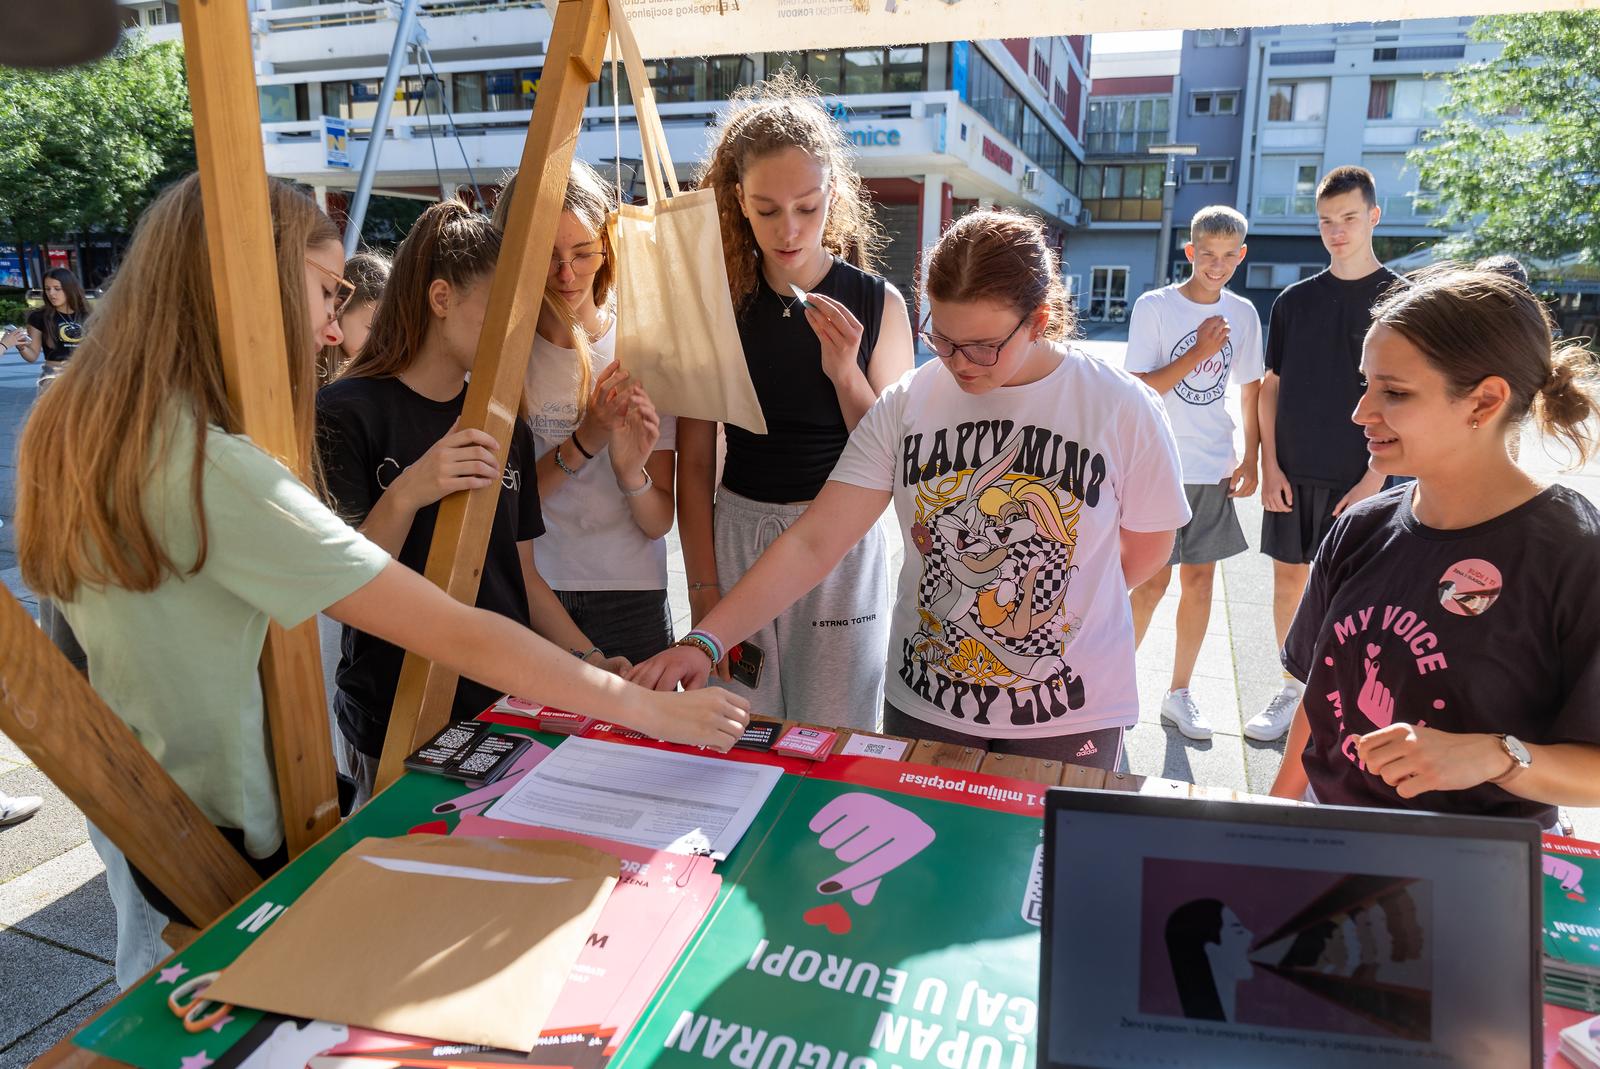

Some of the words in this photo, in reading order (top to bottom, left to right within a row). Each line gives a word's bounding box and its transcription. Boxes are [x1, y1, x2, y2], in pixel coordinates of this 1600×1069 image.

[903, 419, 1014, 487] HAPPY
[819, 620, 848, 628] STRNG
[851, 614, 876, 625] TGTHR
[1334, 606, 1374, 645] MY
[1382, 605, 1448, 675] VOICE
[898, 637, 1000, 725] HAPPY
[1007, 665, 1085, 725] LIFE
[899, 772, 967, 792] potpisa!
[967, 782, 1023, 801] milijun
[1026, 793, 1036, 806] 1
[746, 938, 909, 1005] EUROPI
[913, 977, 949, 1016] U
